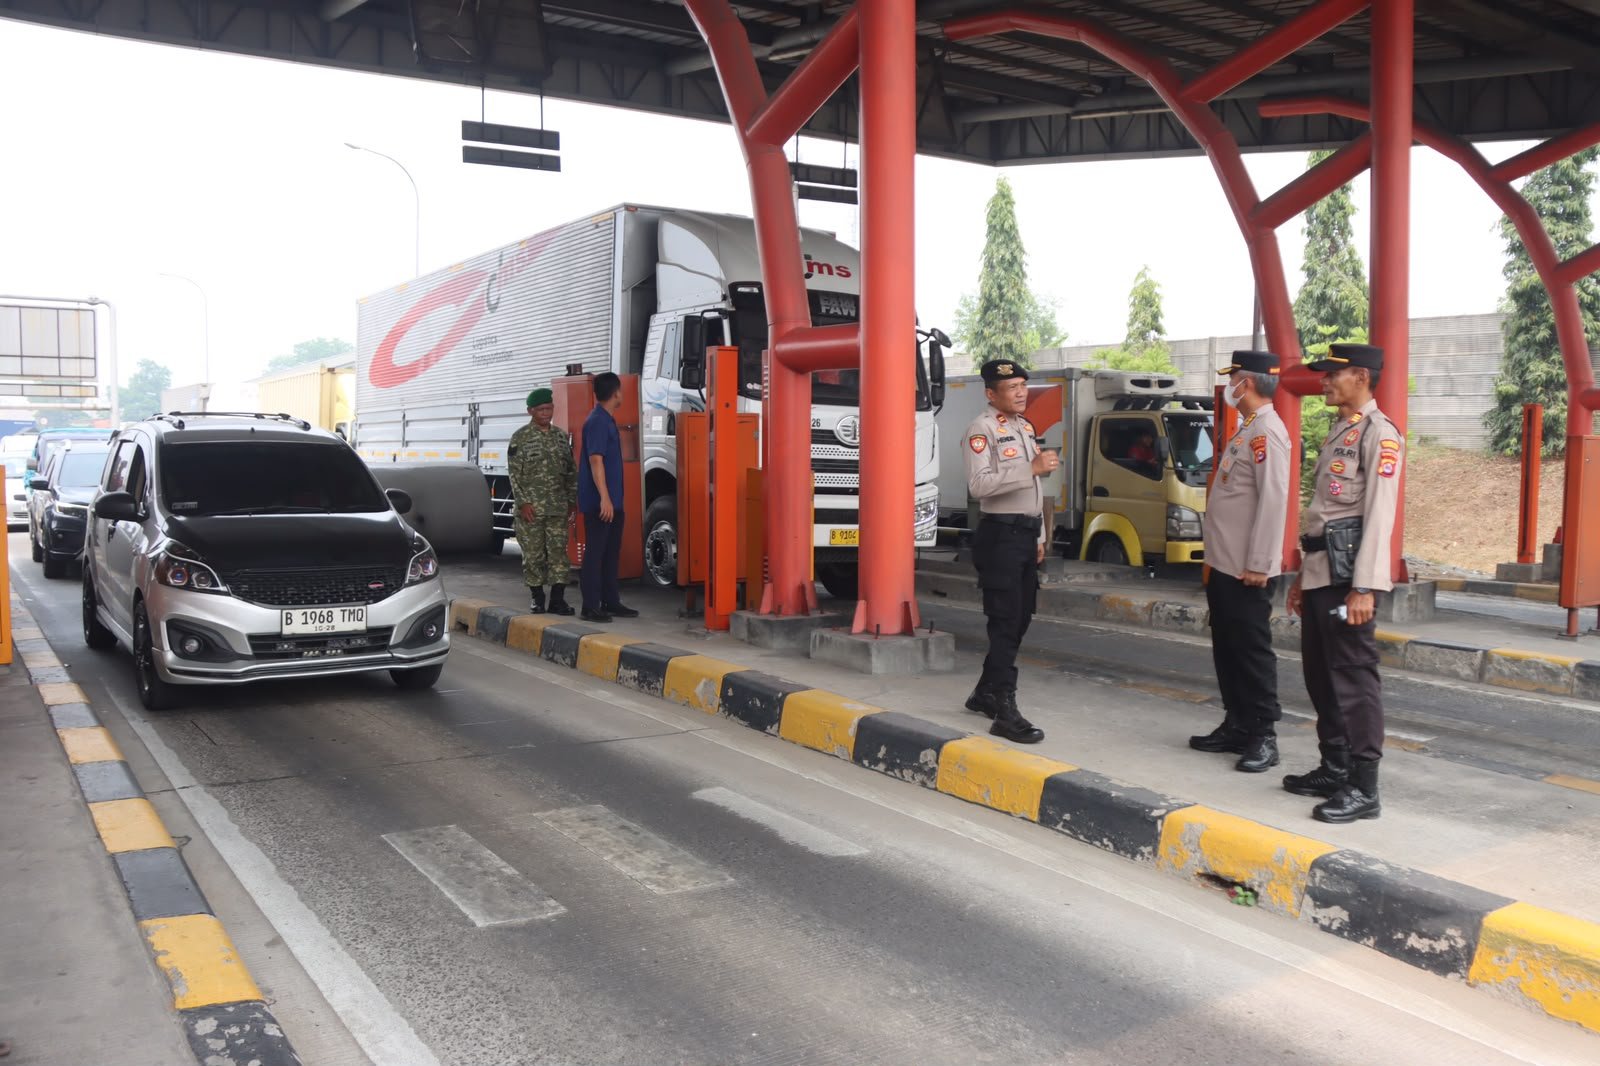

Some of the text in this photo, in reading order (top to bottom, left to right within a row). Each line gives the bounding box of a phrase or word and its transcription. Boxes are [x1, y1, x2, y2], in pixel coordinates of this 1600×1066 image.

[820, 301, 856, 317] FAW
[1333, 447, 1357, 459] POLRI
[831, 530, 836, 540] B
[285, 608, 364, 625] B 1968 TMQ
